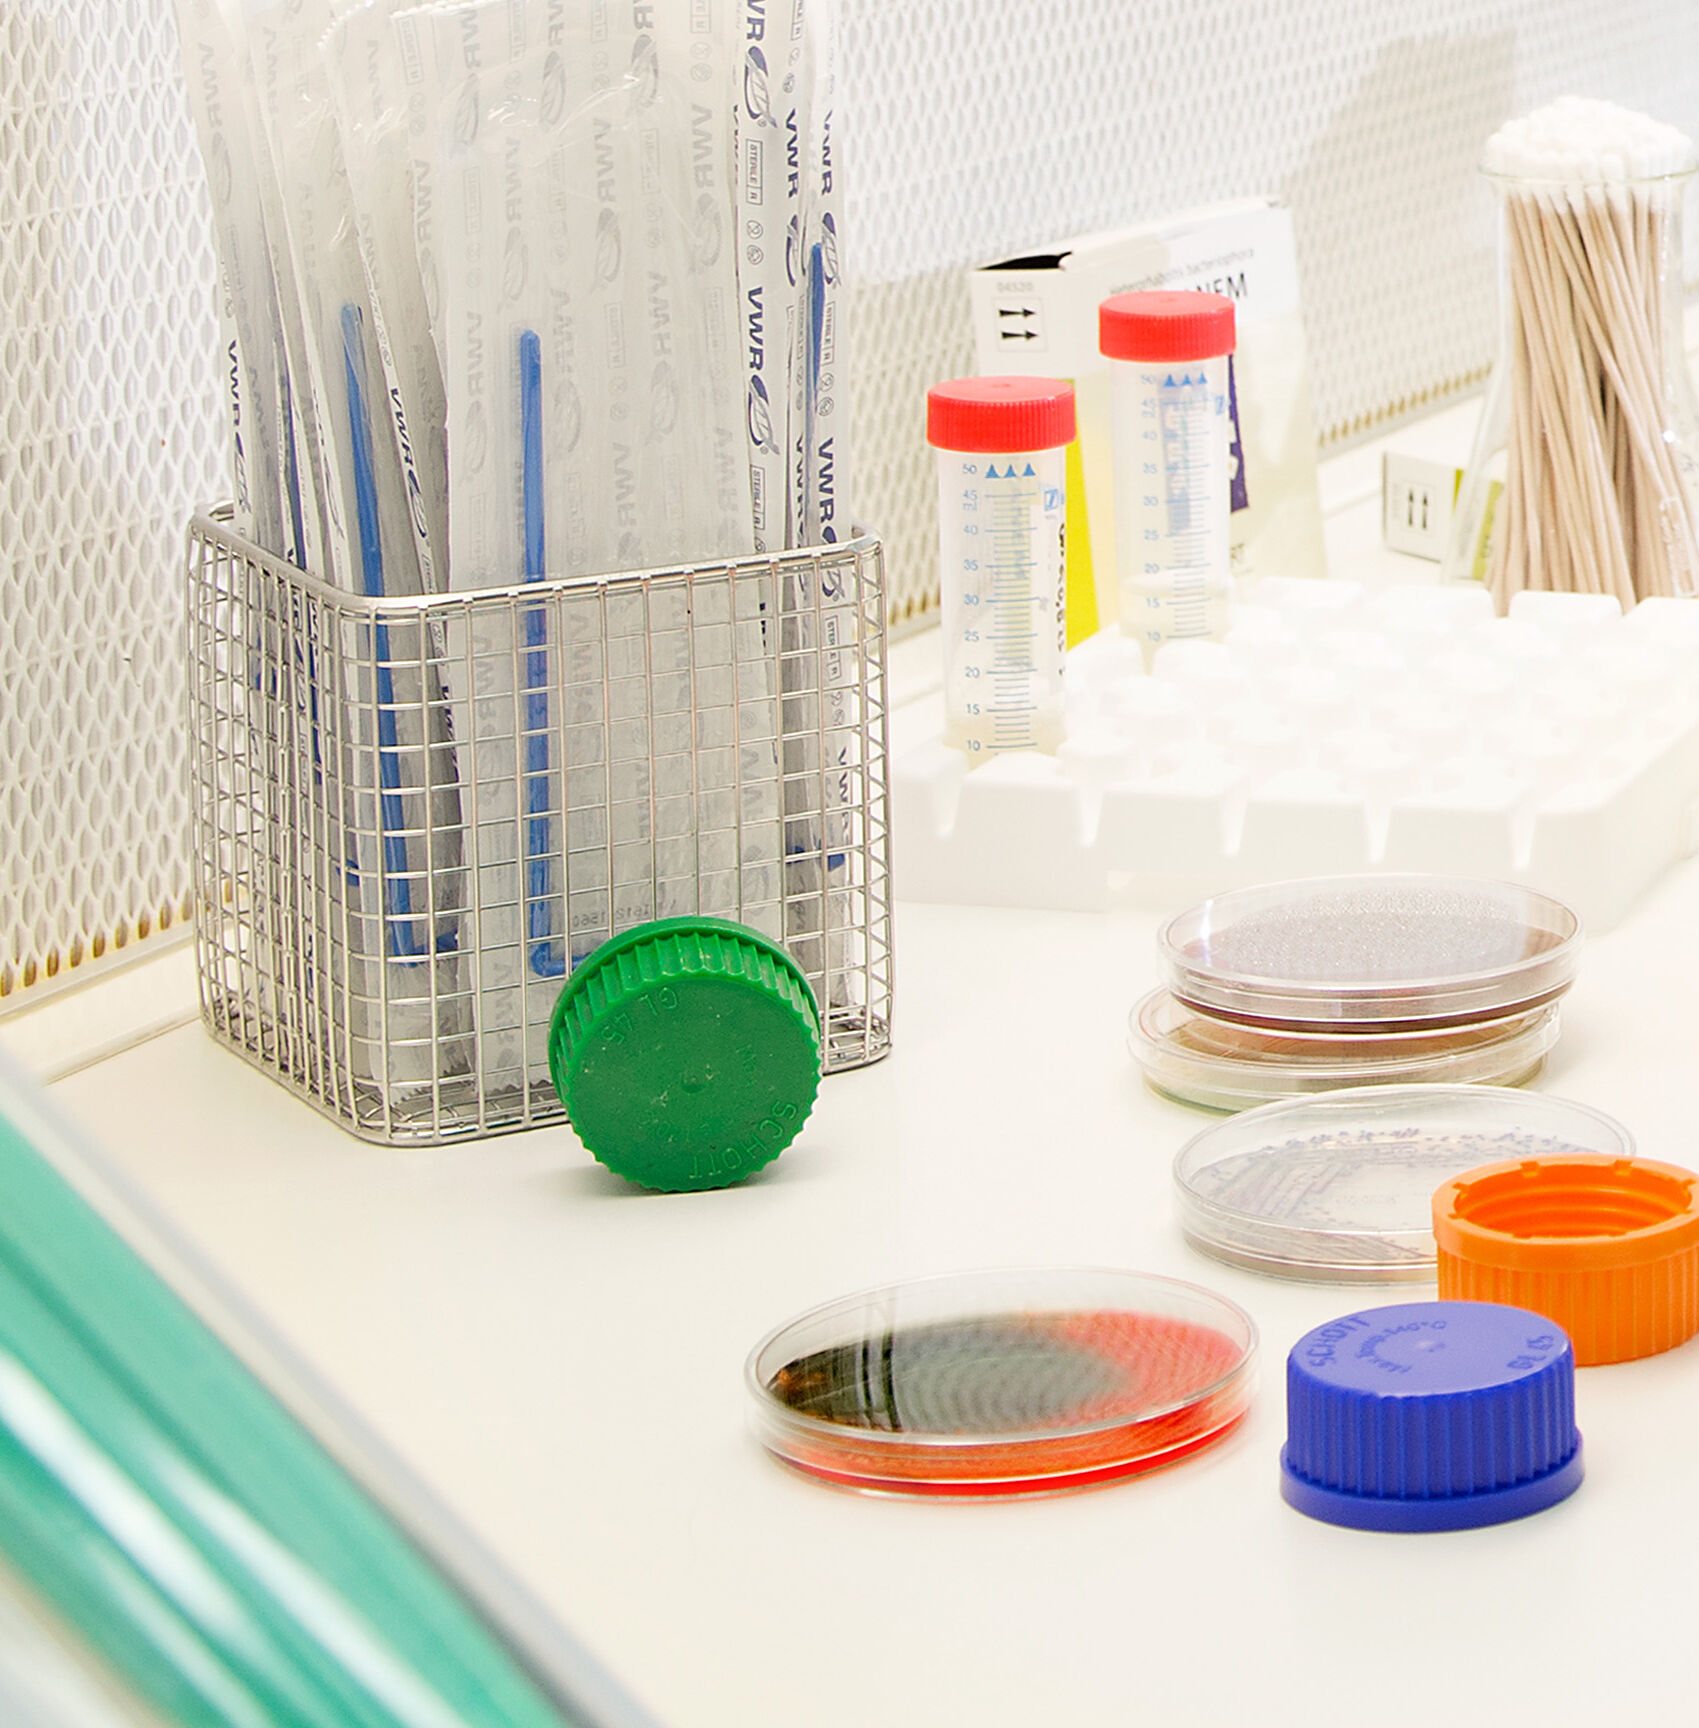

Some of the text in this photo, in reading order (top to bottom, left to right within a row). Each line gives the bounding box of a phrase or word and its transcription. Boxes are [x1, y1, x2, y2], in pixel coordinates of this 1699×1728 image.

[784, 107, 800, 199] VWR
[747, 286, 764, 371] VWR
[962, 464, 978, 474] 50
[817, 436, 835, 524] VWR
[963, 561, 979, 571] 35
[964, 596, 980, 606] 30
[1145, 599, 1161, 608] 15
[964, 631, 980, 642] 25
[964, 667, 980, 678] 20
[966, 704, 980, 715] 15
[966, 741, 981, 751] 10
[601, 1014, 634, 1046] 45
[688, 1101, 798, 1179] SCHOTT
[1306, 1316, 1371, 1368] SCHOTT
